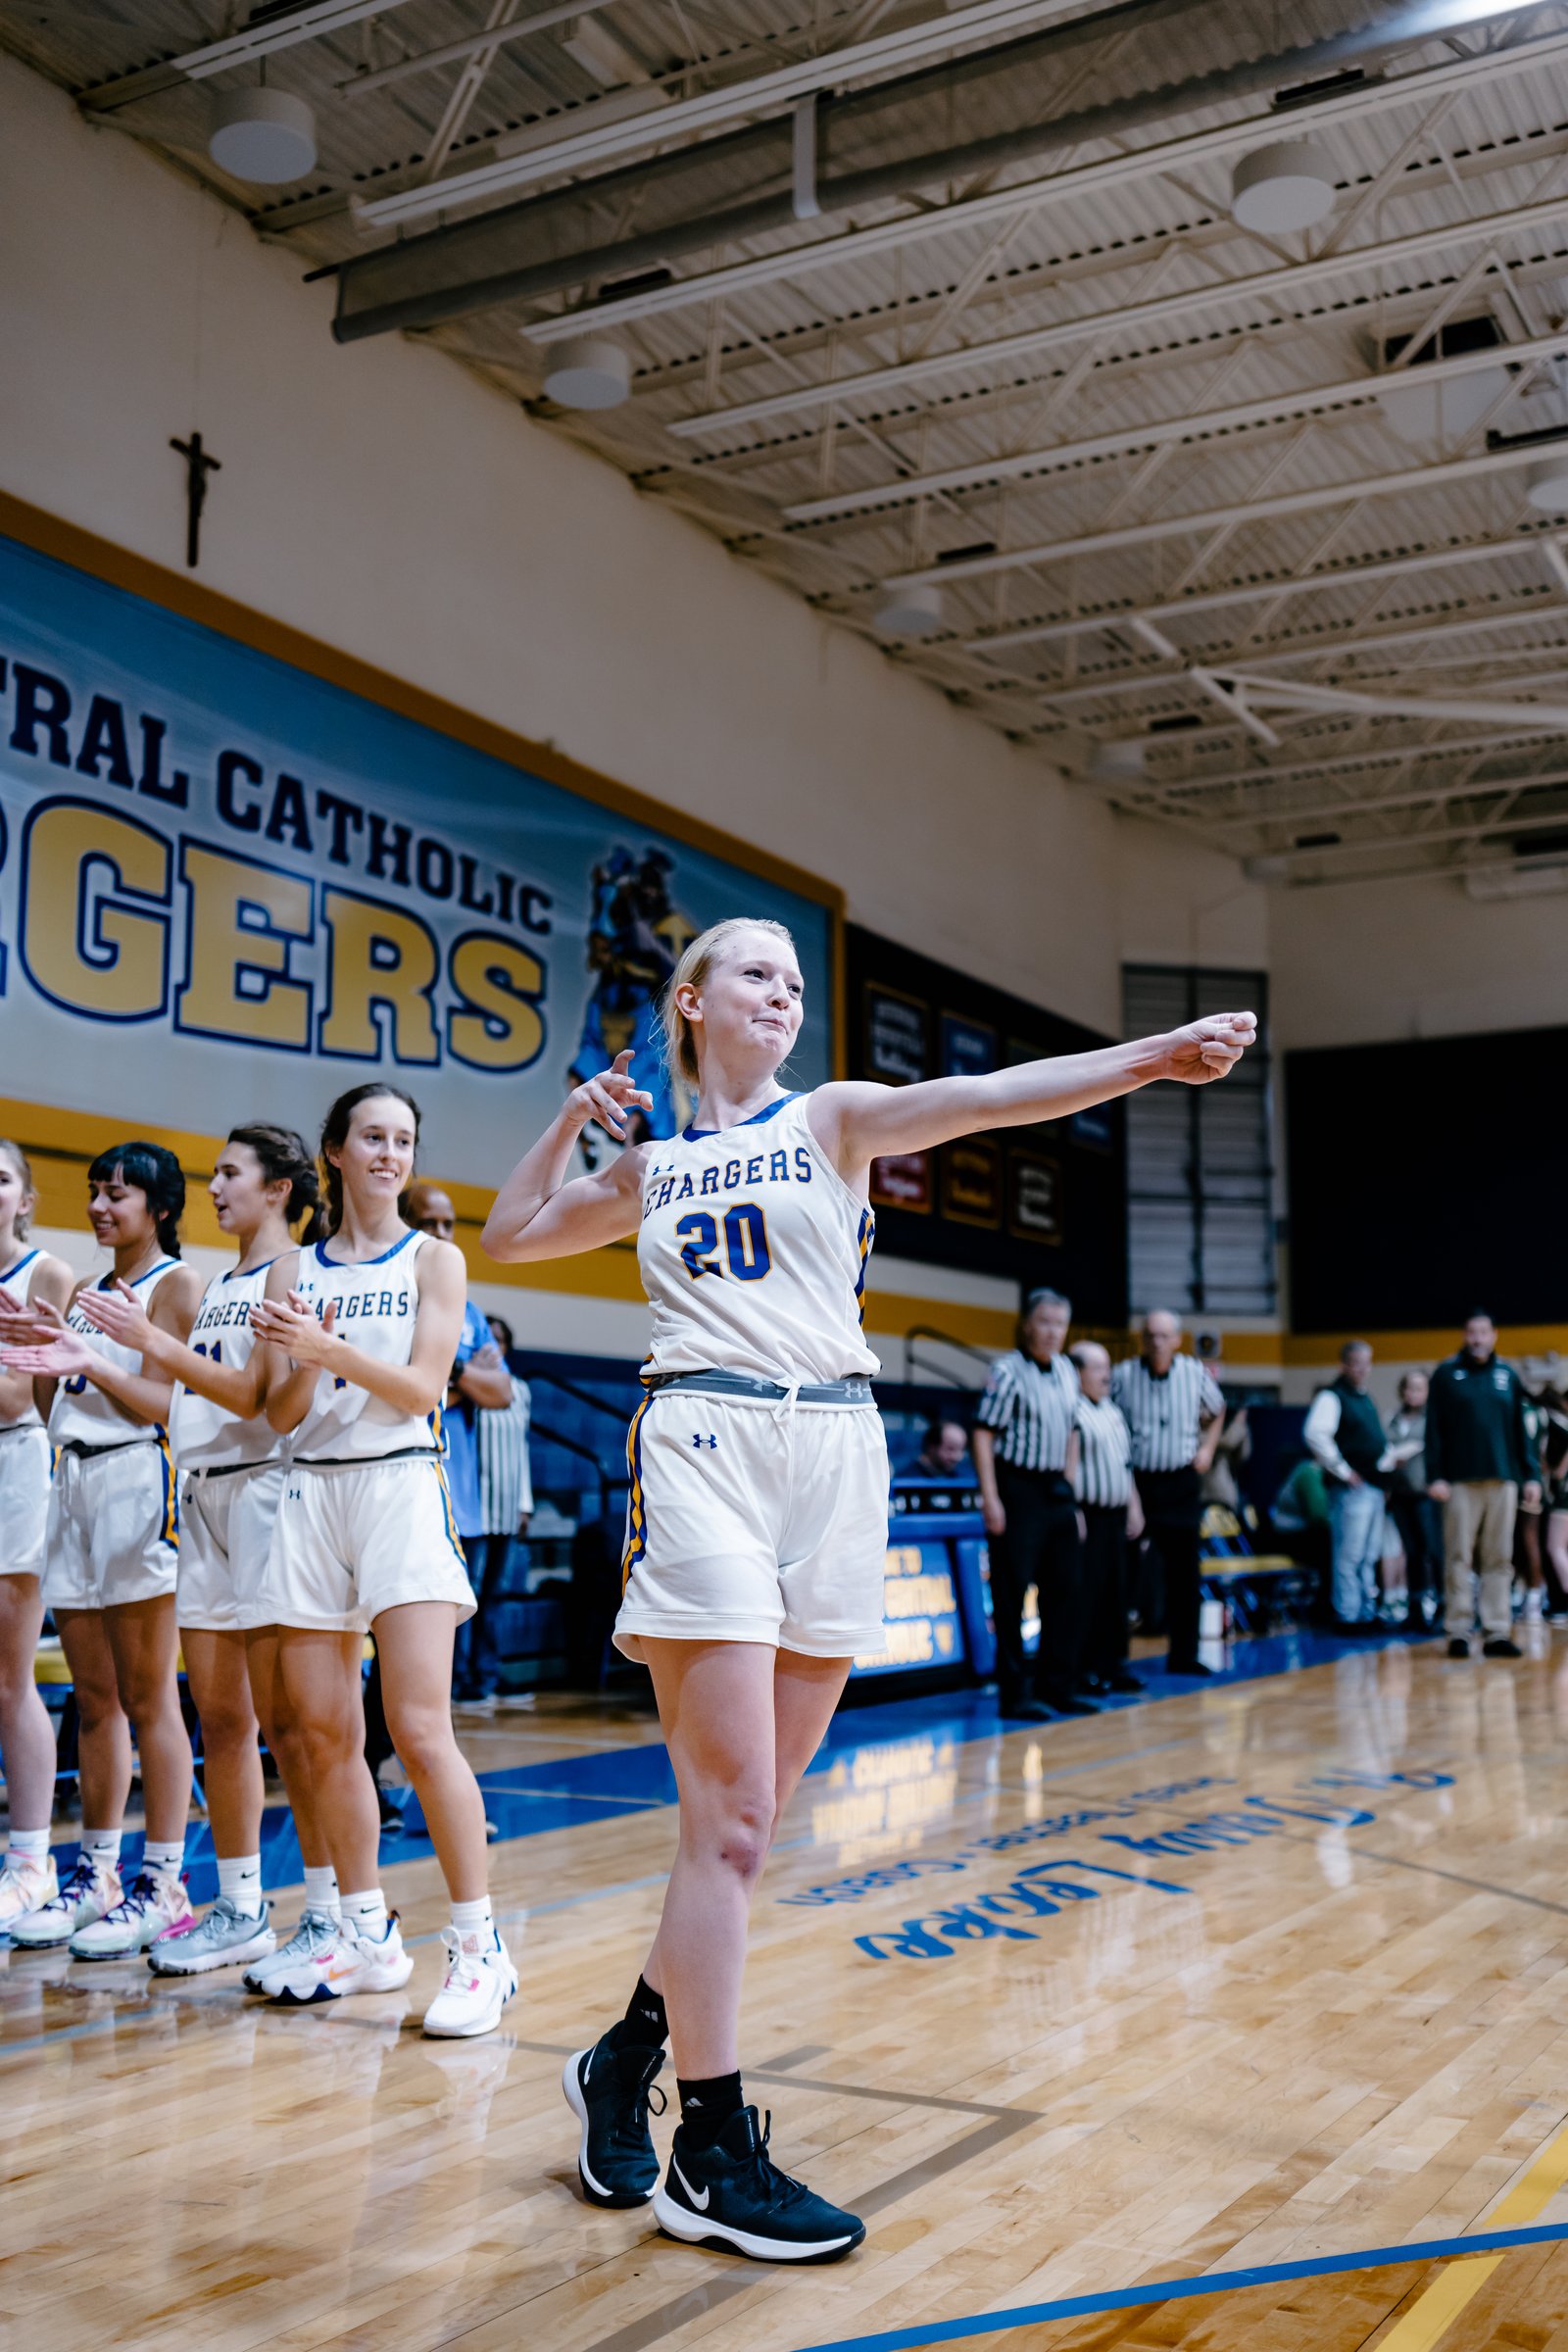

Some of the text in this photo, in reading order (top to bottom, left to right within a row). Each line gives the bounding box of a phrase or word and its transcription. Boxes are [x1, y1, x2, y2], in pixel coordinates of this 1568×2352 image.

[216, 749, 552, 935] CATHOLIC
[0, 794, 548, 1074] GERS
[643, 1147, 812, 1220] CHARGERS
[674, 1200, 773, 1283] 20
[308, 1291, 409, 1322] ARGERS
[774, 1858, 965, 1907] Coach
